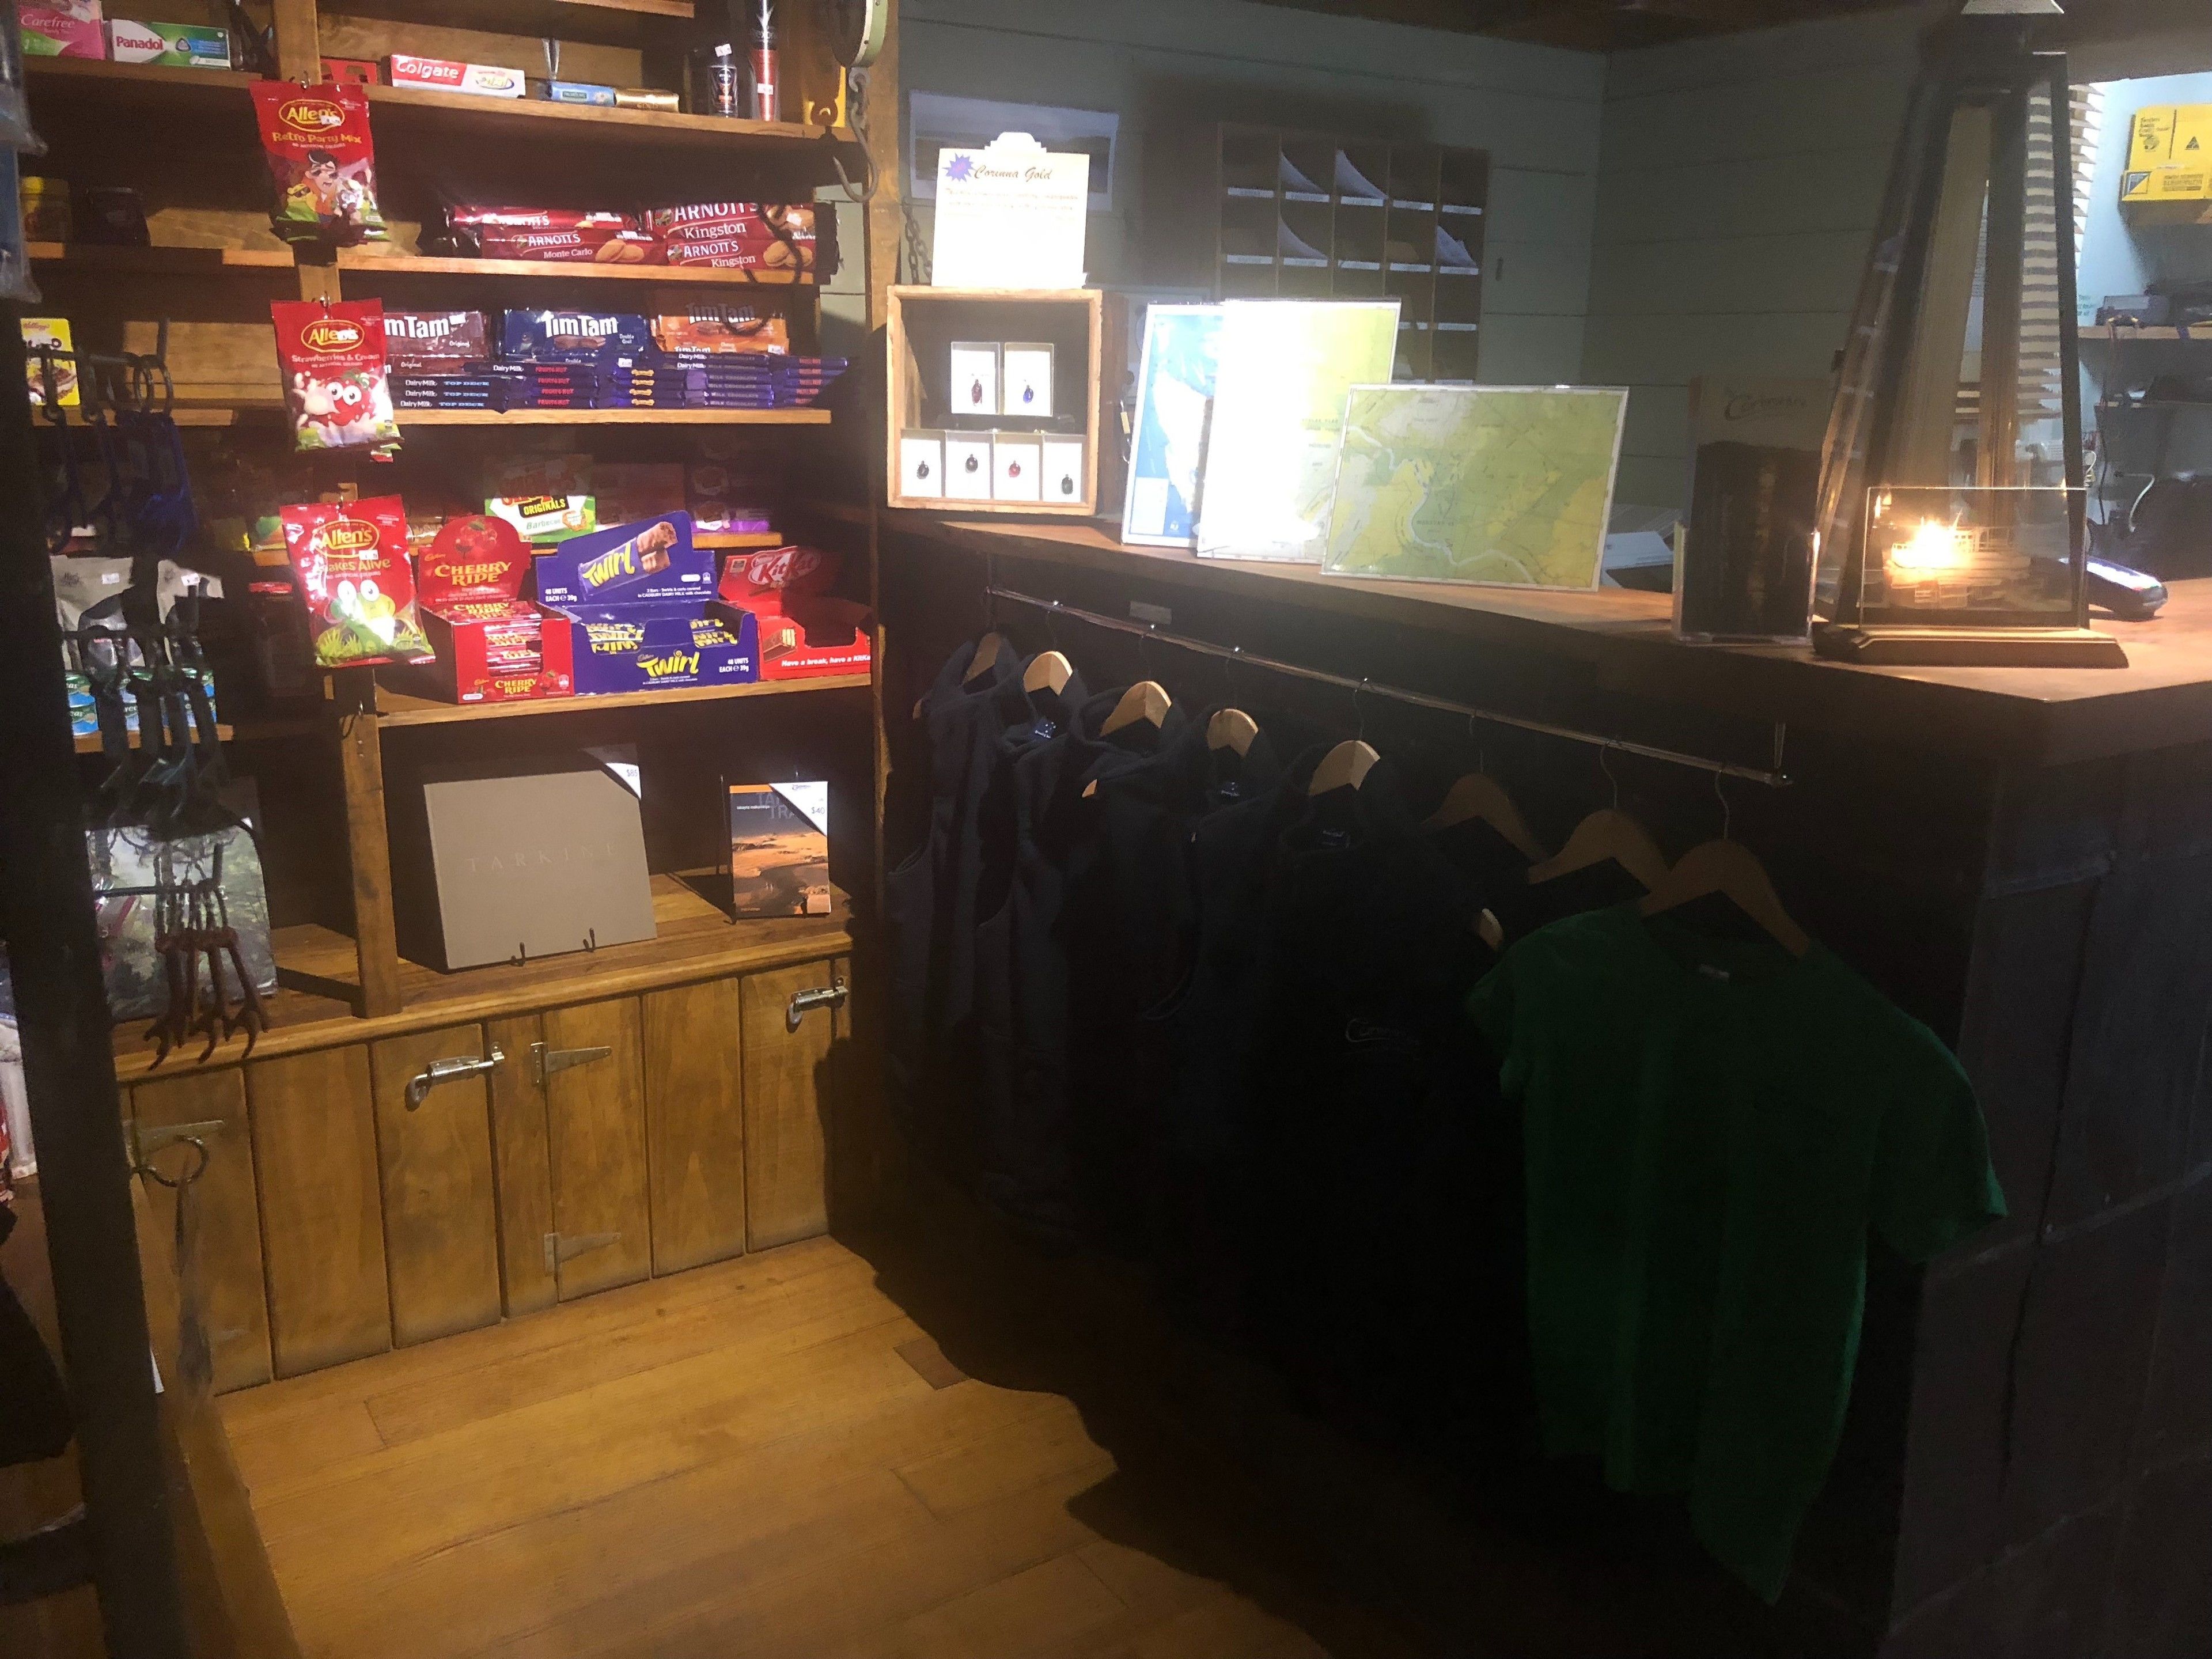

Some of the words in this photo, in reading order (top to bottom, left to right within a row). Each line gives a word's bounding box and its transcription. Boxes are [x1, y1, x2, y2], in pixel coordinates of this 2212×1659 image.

[20, 14, 75, 28] Carefree
[116, 36, 164, 50] Panadol
[396, 59, 460, 79] Colgate
[272, 131, 305, 143] Retro
[307, 133, 339, 144] Party
[340, 133, 362, 144] Mix
[1025, 167, 1053, 183] Gold
[684, 222, 747, 240] Kingston
[528, 234, 581, 247] ARNOTT'S
[543, 251, 570, 259] Monte
[571, 248, 593, 257] Carlo
[683, 240, 740, 258] ARNOTT'S
[710, 255, 756, 268] Kingston
[291, 354, 346, 363] Strawberries
[523, 498, 566, 516] ORIGINALS
[328, 561, 357, 571] akes
[358, 558, 392, 571] Alive
[434, 561, 512, 578] CHERRY
[452, 573, 499, 586] RIPE
[495, 678, 537, 689] CHERRY
[505, 685, 532, 695] RIPE
[811, 807, 825, 815] $40
